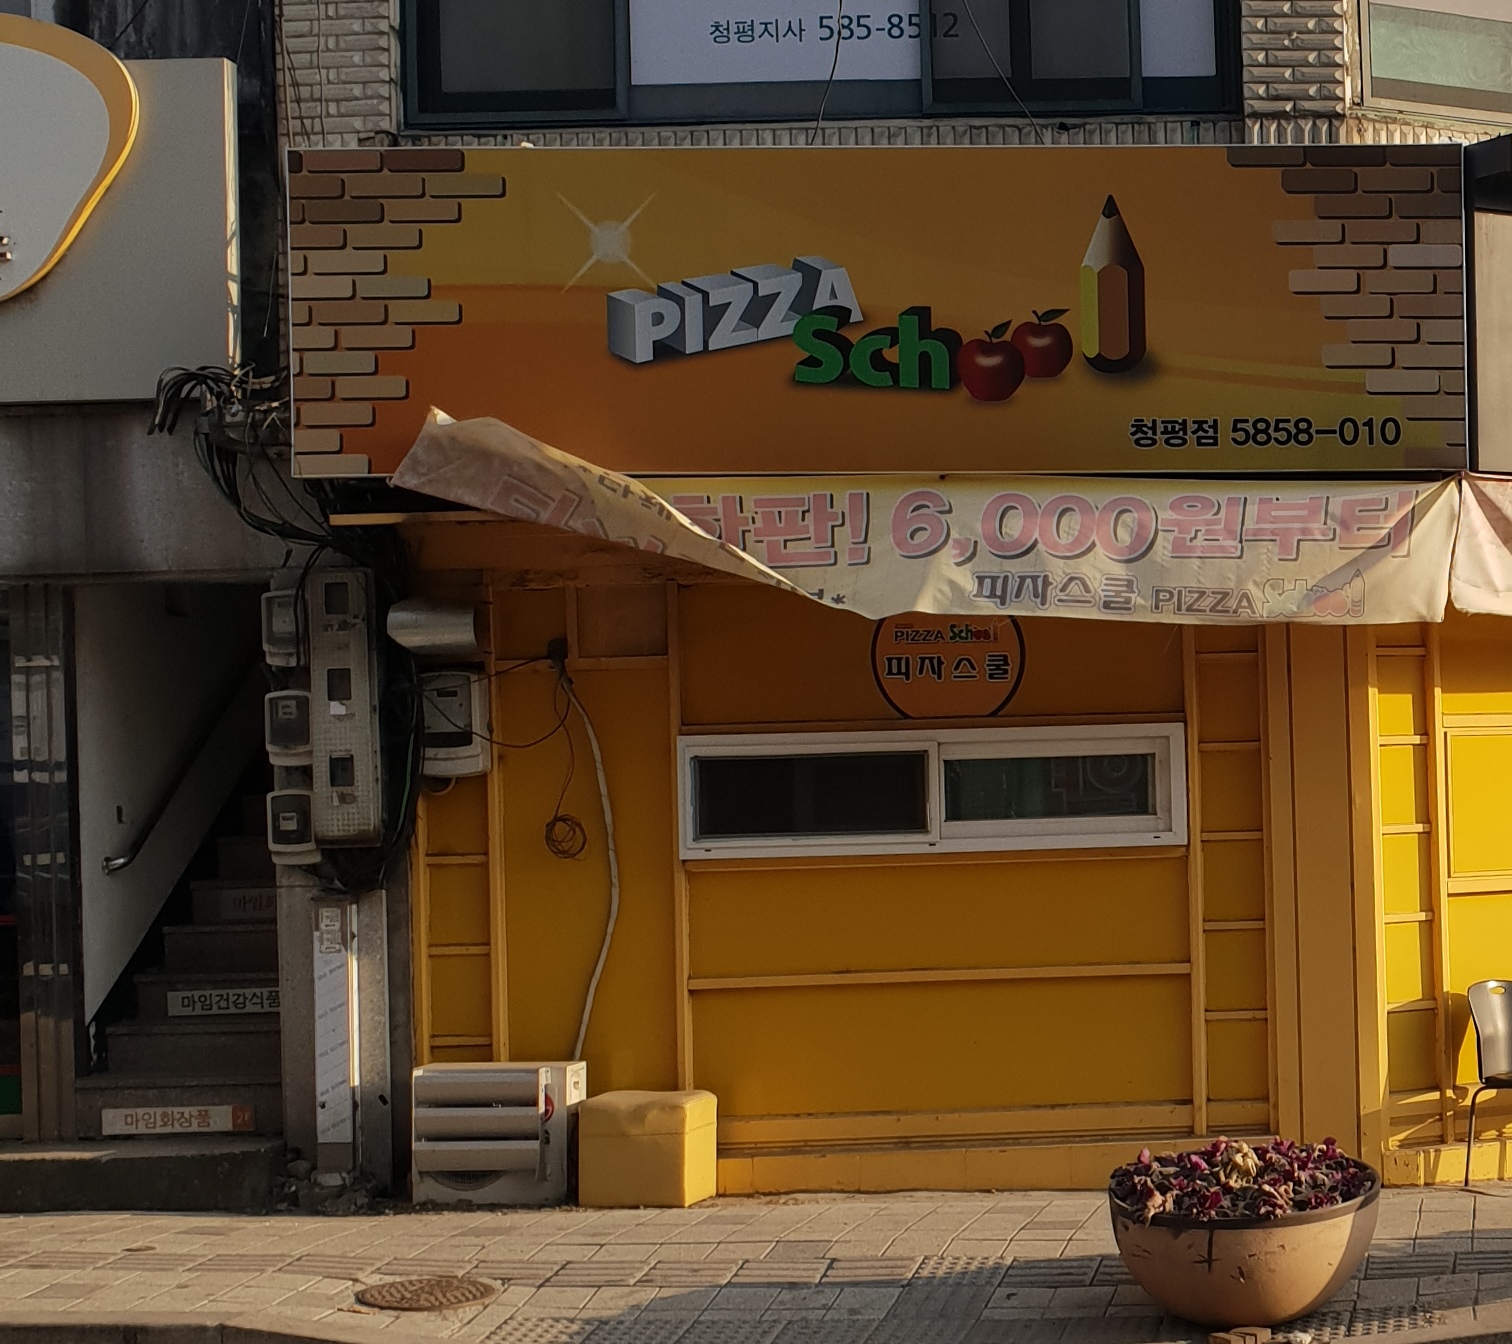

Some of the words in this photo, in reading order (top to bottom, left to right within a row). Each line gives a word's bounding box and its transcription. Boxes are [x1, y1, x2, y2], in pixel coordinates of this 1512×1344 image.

[708, 18, 806, 45] 청평지사
[608, 255, 866, 365] PIZZA
[1127, 417, 1221, 450] 청평점
[1229, 416, 1402, 449] 5858-010
[889, 488, 1420, 563] 6,000원부터
[969, 570, 1141, 615] 피자스쿨
[1152, 585, 1260, 618] PIZZA
[893, 628, 946, 644] PIZZA
[883, 652, 1013, 684] 피자스쿨
[180, 989, 281, 1012] 마임건강식품
[124, 1109, 212, 1130] 마임화장품
